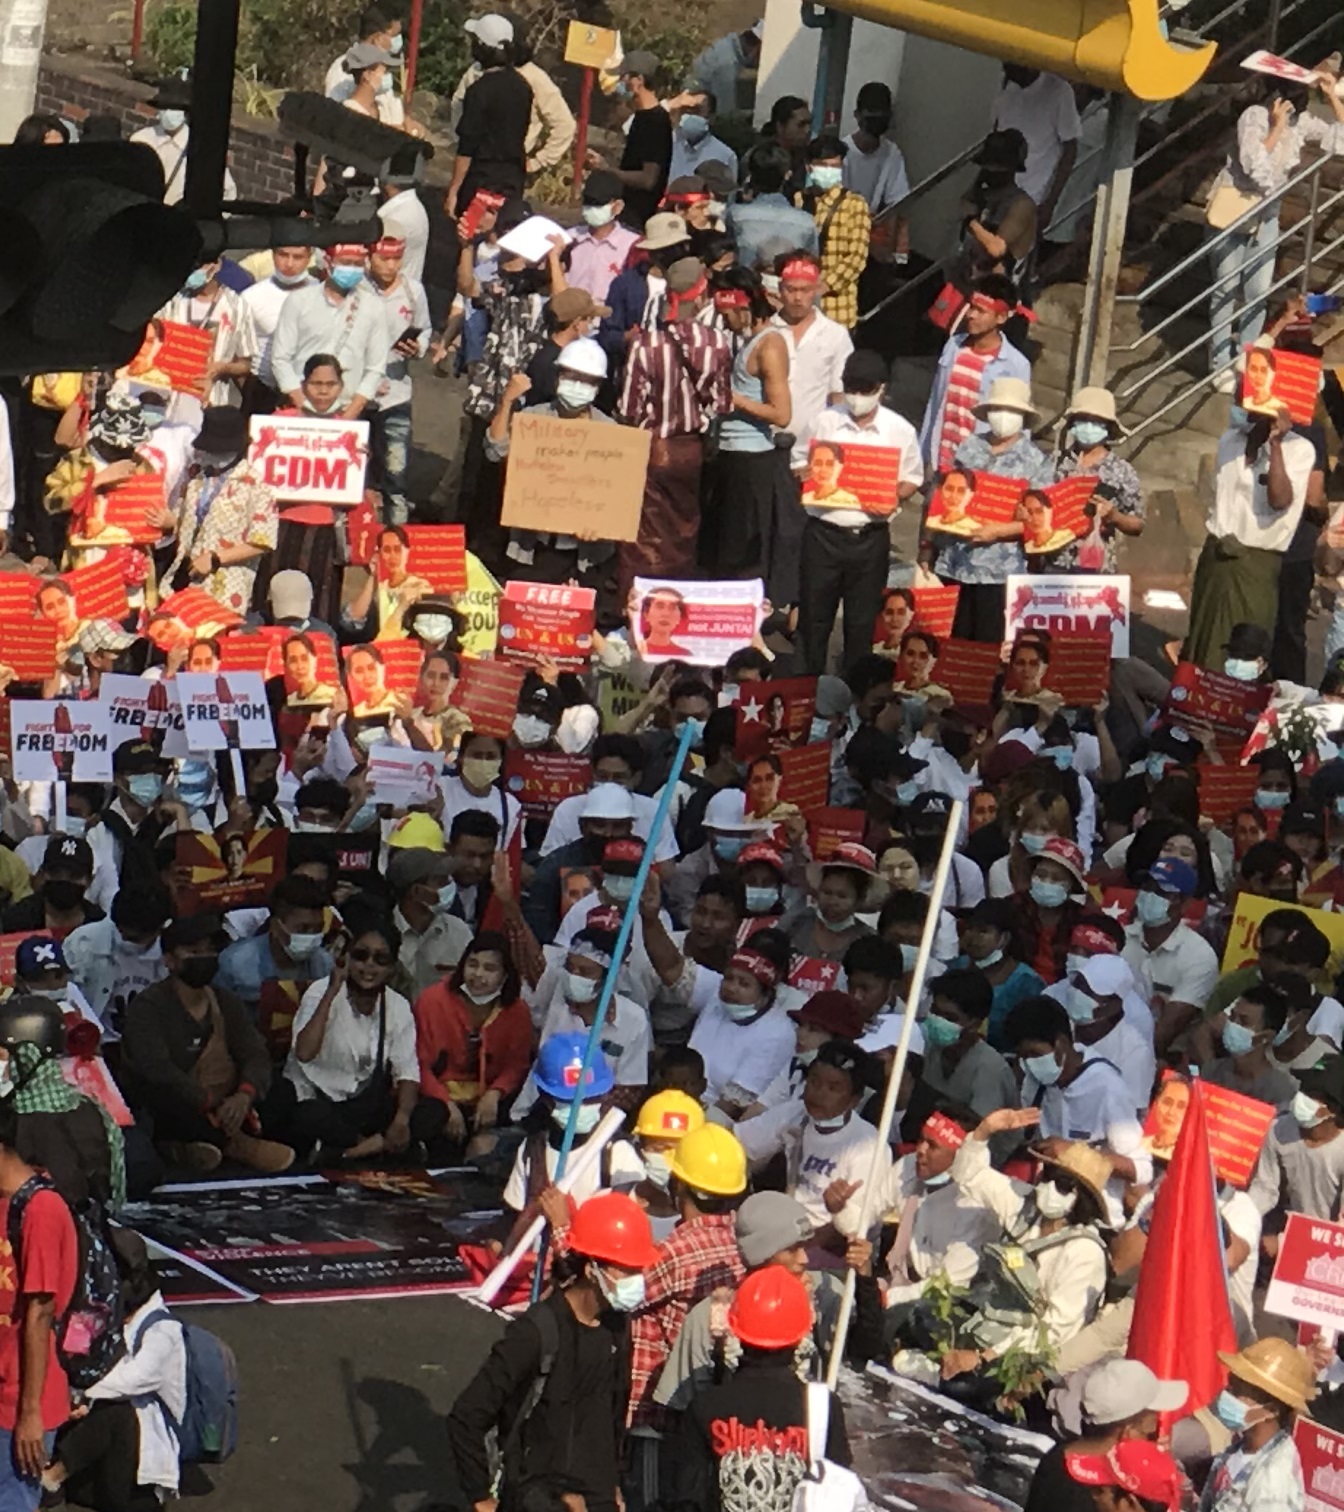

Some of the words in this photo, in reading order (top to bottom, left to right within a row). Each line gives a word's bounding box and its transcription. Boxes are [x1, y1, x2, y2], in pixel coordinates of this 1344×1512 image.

[263, 455, 348, 490] CDM
[526, 587, 572, 606] FREE
[539, 631, 550, 644] &
[114, 697, 147, 706] FIGHT
[192, 694, 217, 702] FIGHT
[233, 694, 249, 702] FOR
[25, 724, 55, 732] FIGHT
[73, 724, 92, 732] FOR
[16, 733, 108, 752] FREEDOM
[1311, 1227, 1331, 1243] WE
[1316, 1434, 1334, 1451] WE
